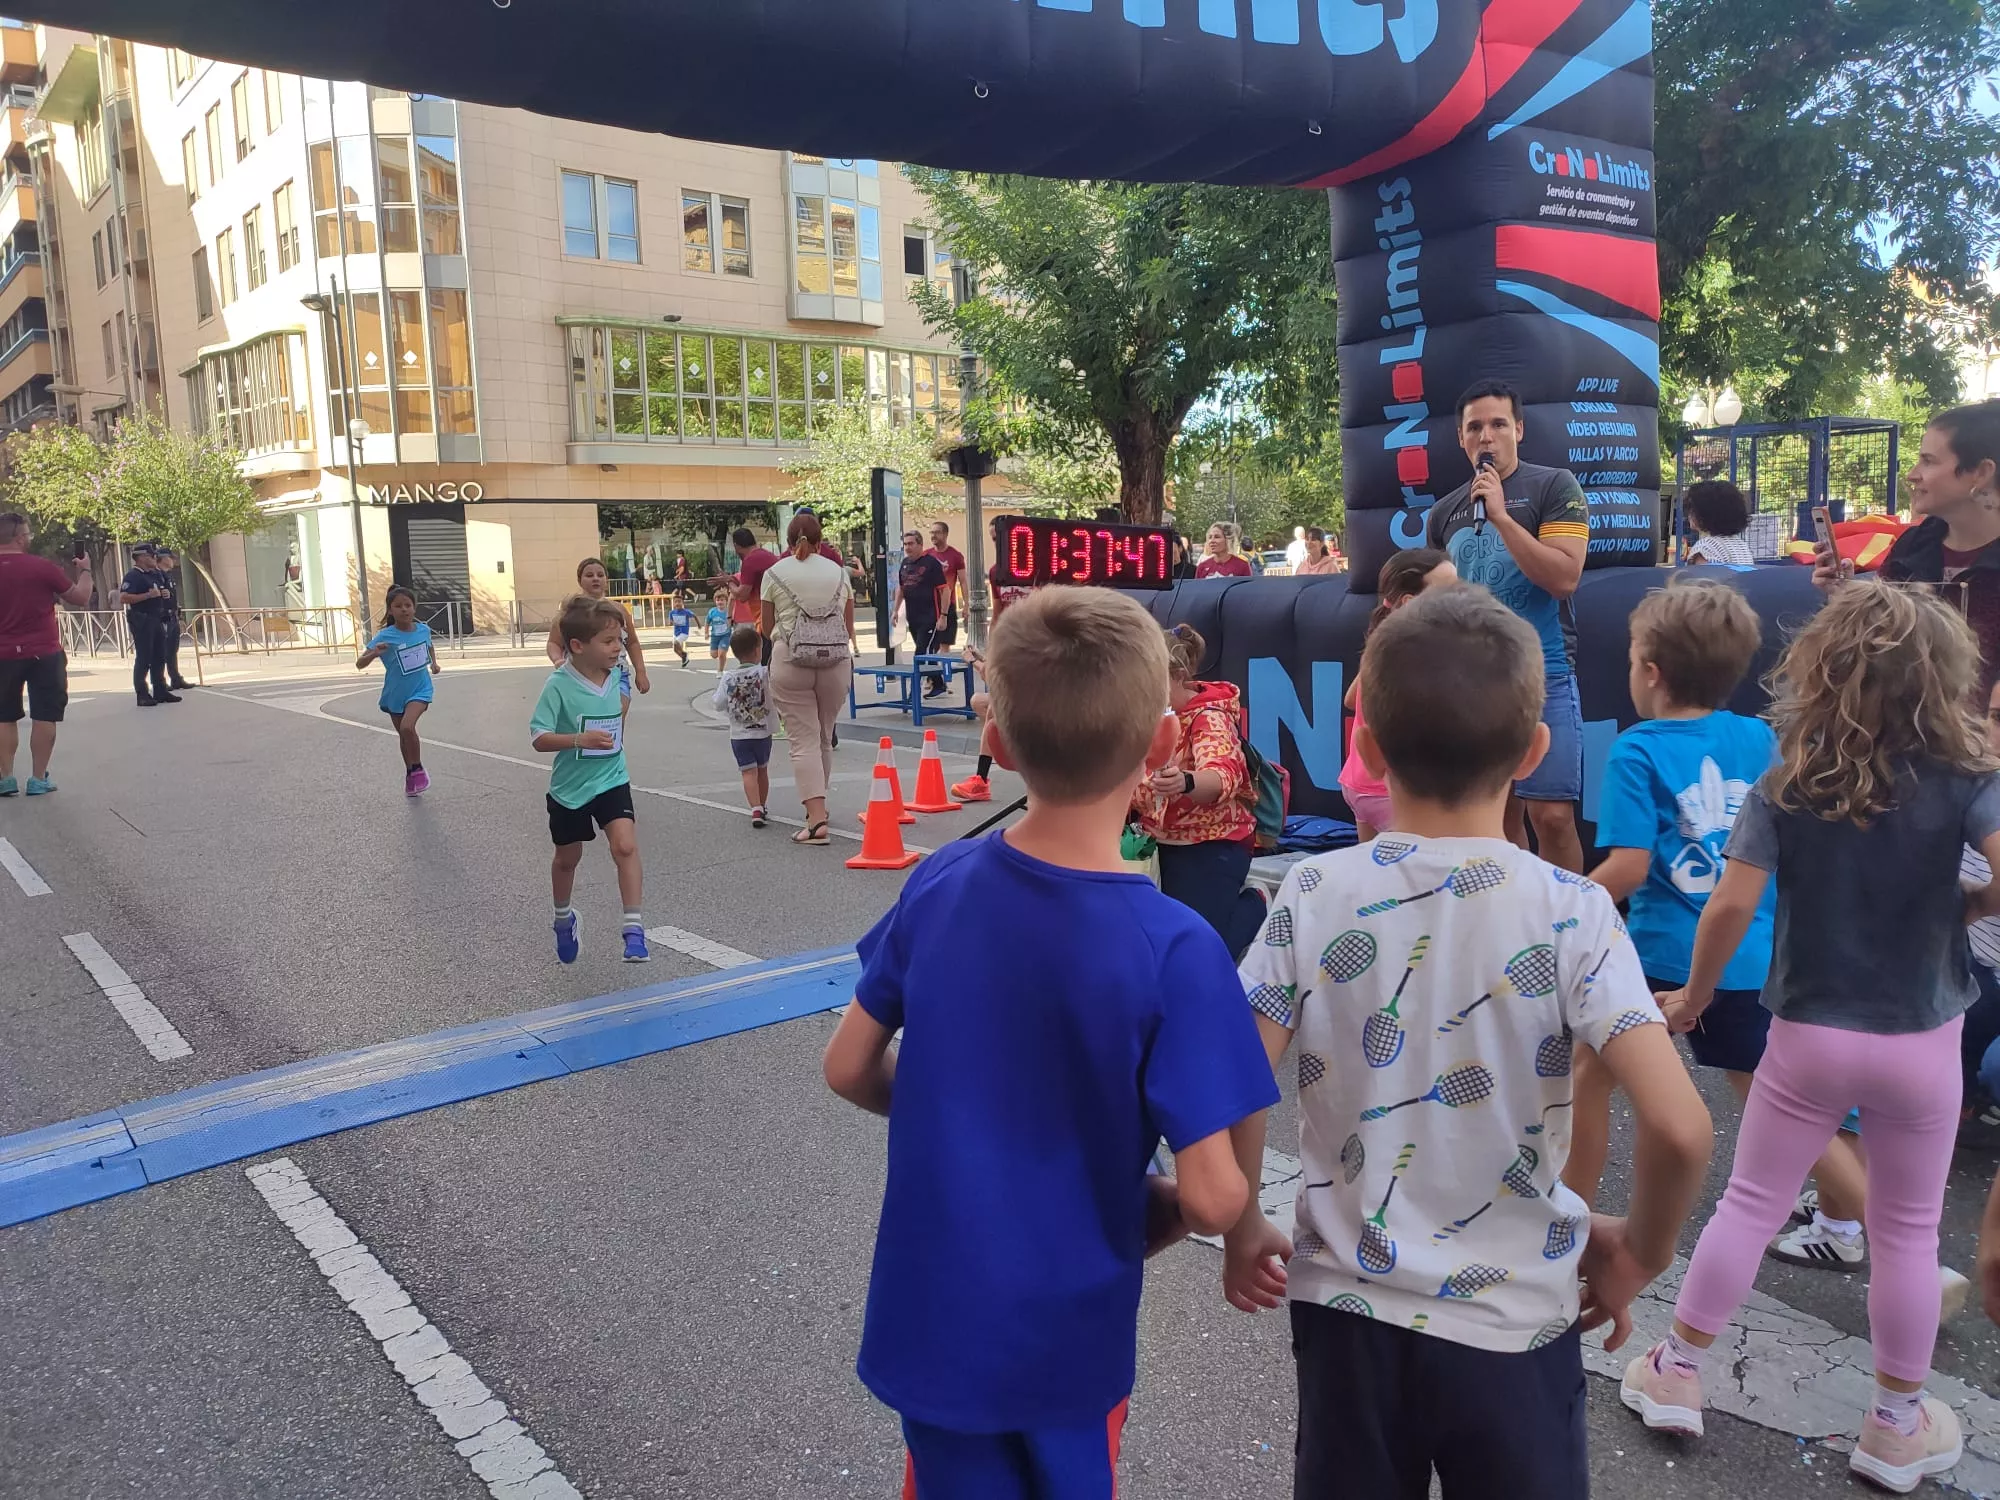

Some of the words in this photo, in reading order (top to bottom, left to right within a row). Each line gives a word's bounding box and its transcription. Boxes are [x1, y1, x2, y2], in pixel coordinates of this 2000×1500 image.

[1546, 184, 1574, 199] Servicio
[1575, 188, 1585, 200] de
[1586, 191, 1630, 209] cronometraje
[1629, 200, 1635, 211] y
[1539, 203, 1566, 217] gestión
[1567, 205, 1577, 218] de
[1577, 208, 1606, 221] eventos
[1605, 210, 1639, 227] deportivos
[1576, 377, 1598, 392] APP
[1598, 378, 1619, 392] LIVE
[1566, 419, 1598, 437] VÍDEO
[1598, 421, 1637, 437] RESUMEN
[1568, 447, 1604, 462] VALLAS
[1606, 446, 1613, 460] Y
[1613, 446, 1639, 461] ARCOS
[1589, 471, 1638, 485] CORREDOR
[368, 481, 483, 504] MANGO
[1602, 491, 1610, 505] Y
[1601, 514, 1610, 529] Y
[1611, 514, 1651, 529] MEDALLAS
[1616, 539, 1624, 552] Y
[1622, 538, 1650, 552] PASIVO
